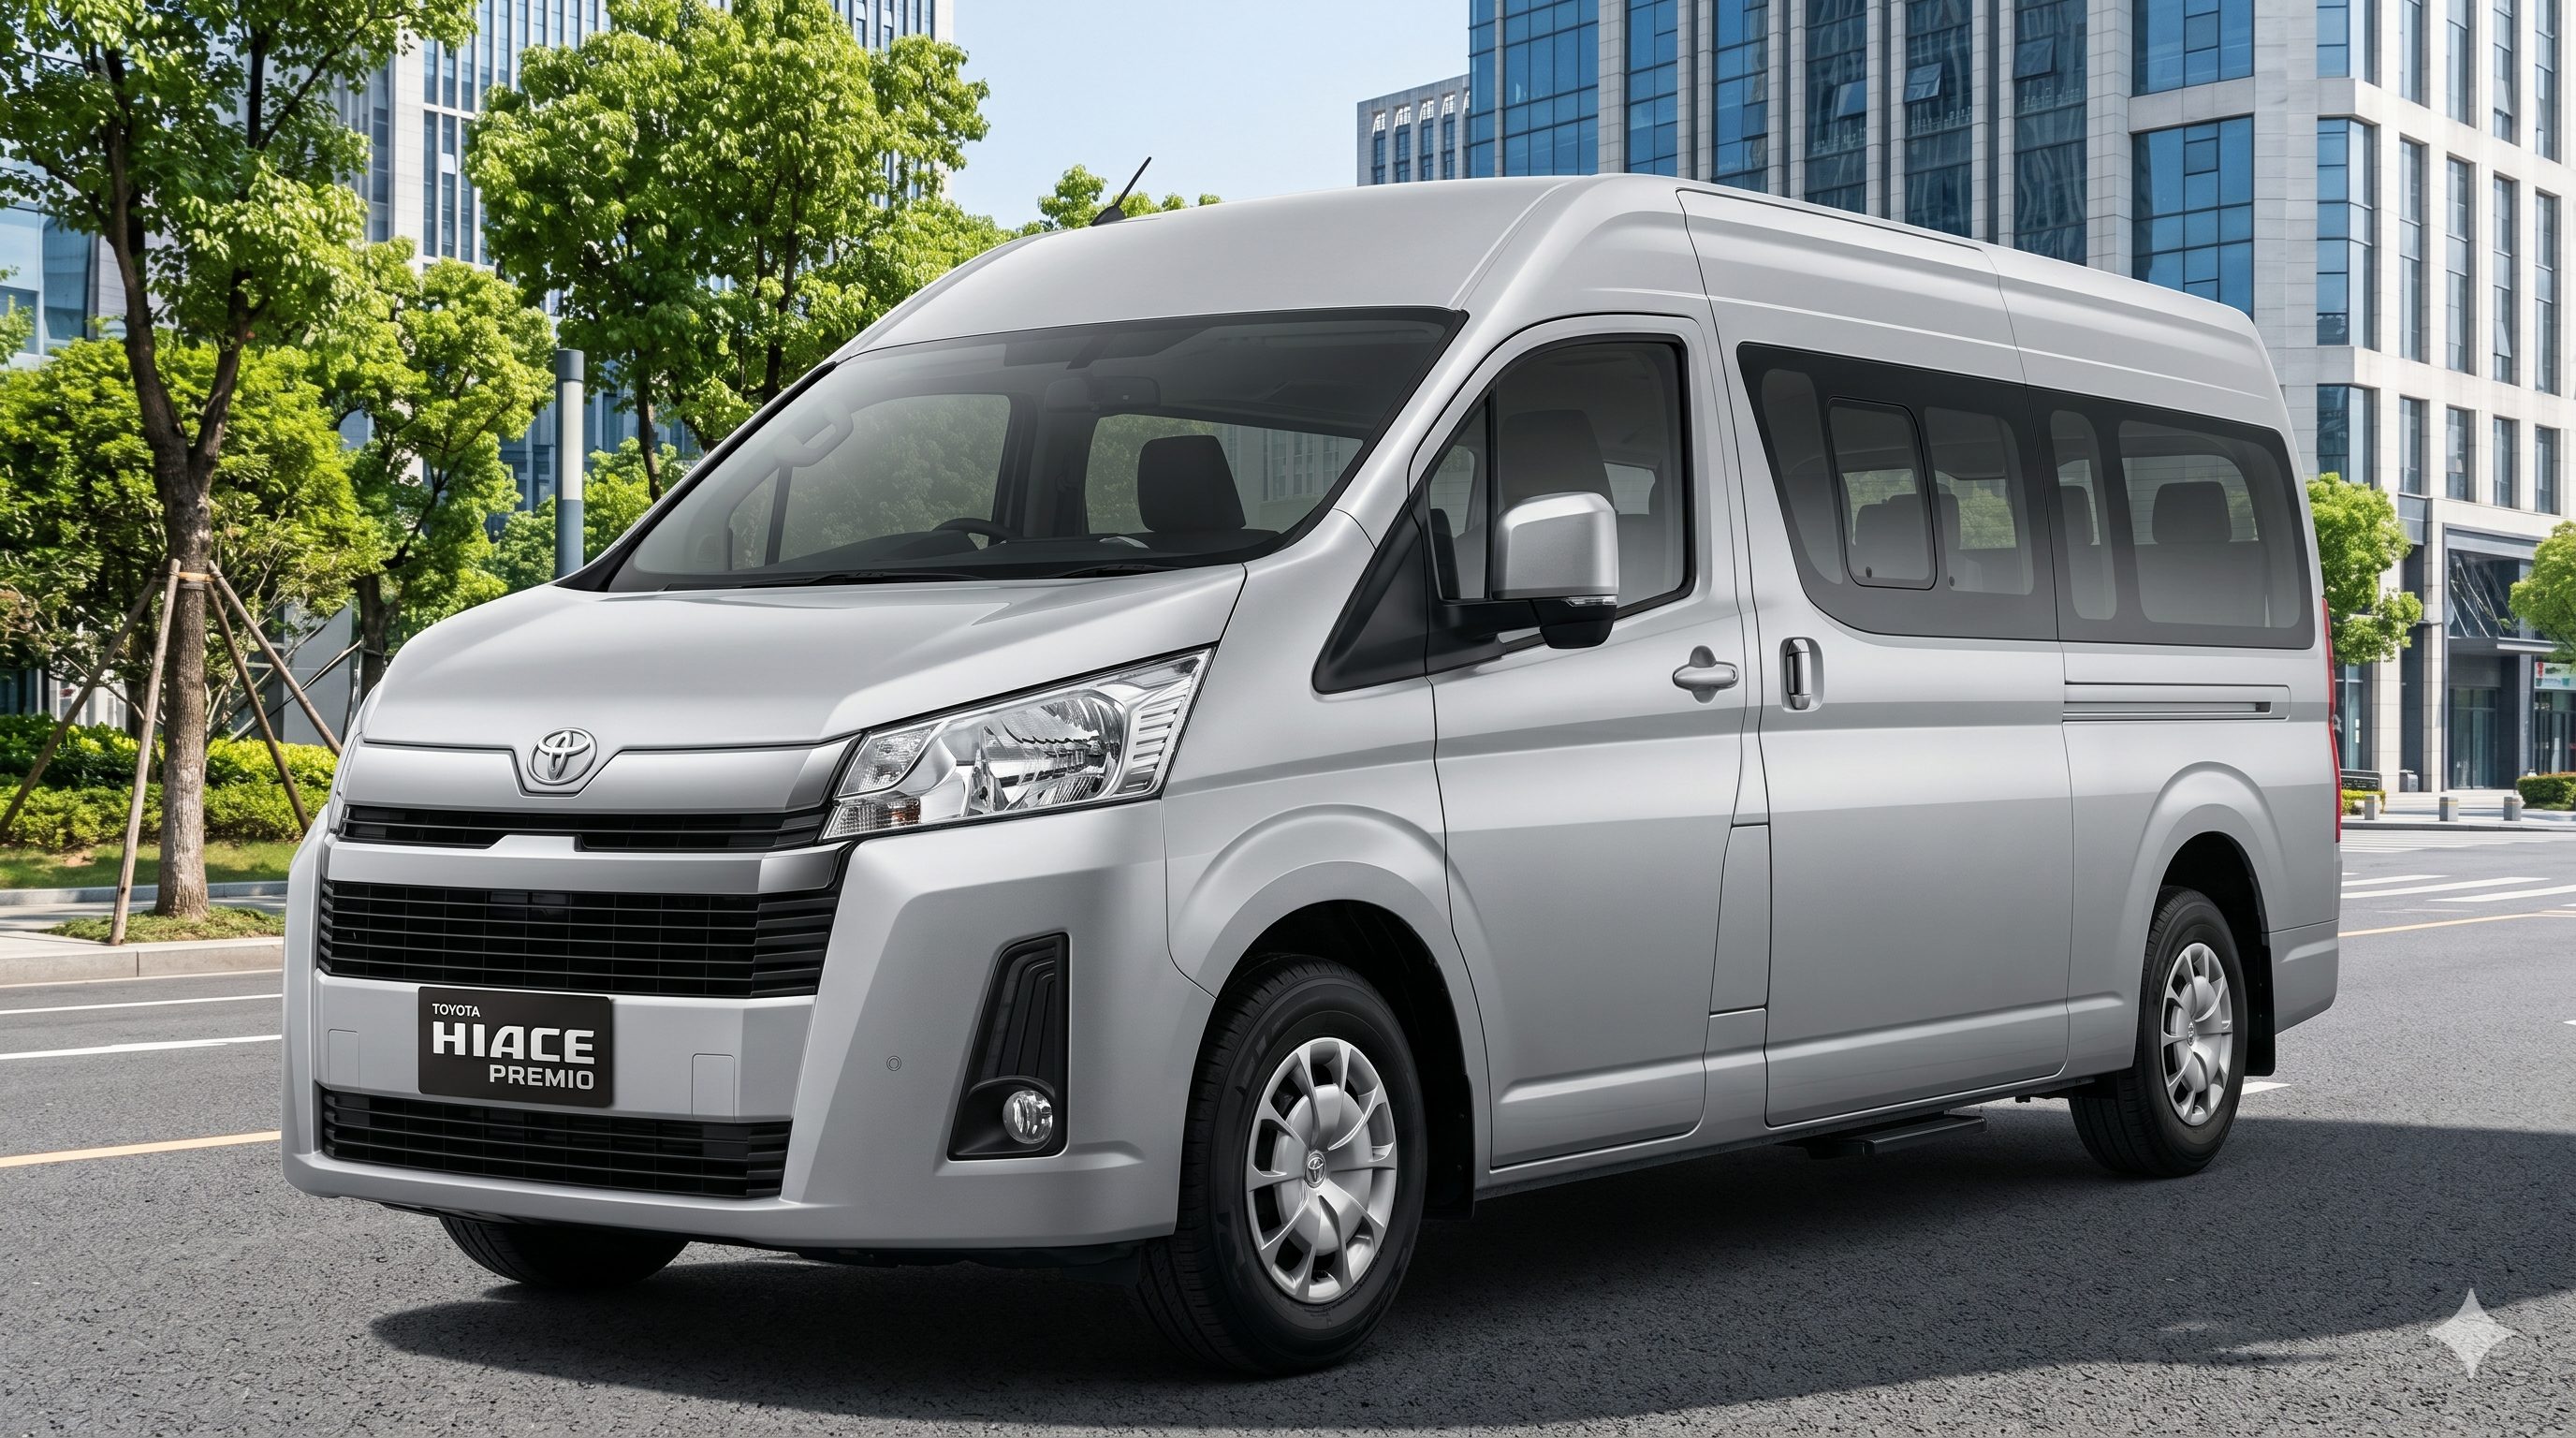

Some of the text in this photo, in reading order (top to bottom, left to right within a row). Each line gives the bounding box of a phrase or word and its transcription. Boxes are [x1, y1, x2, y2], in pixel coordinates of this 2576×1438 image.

[432, 1003, 481, 1018] TOYOTA
[432, 1020, 595, 1064] HIACE
[489, 1064, 594, 1091] PREMIO
